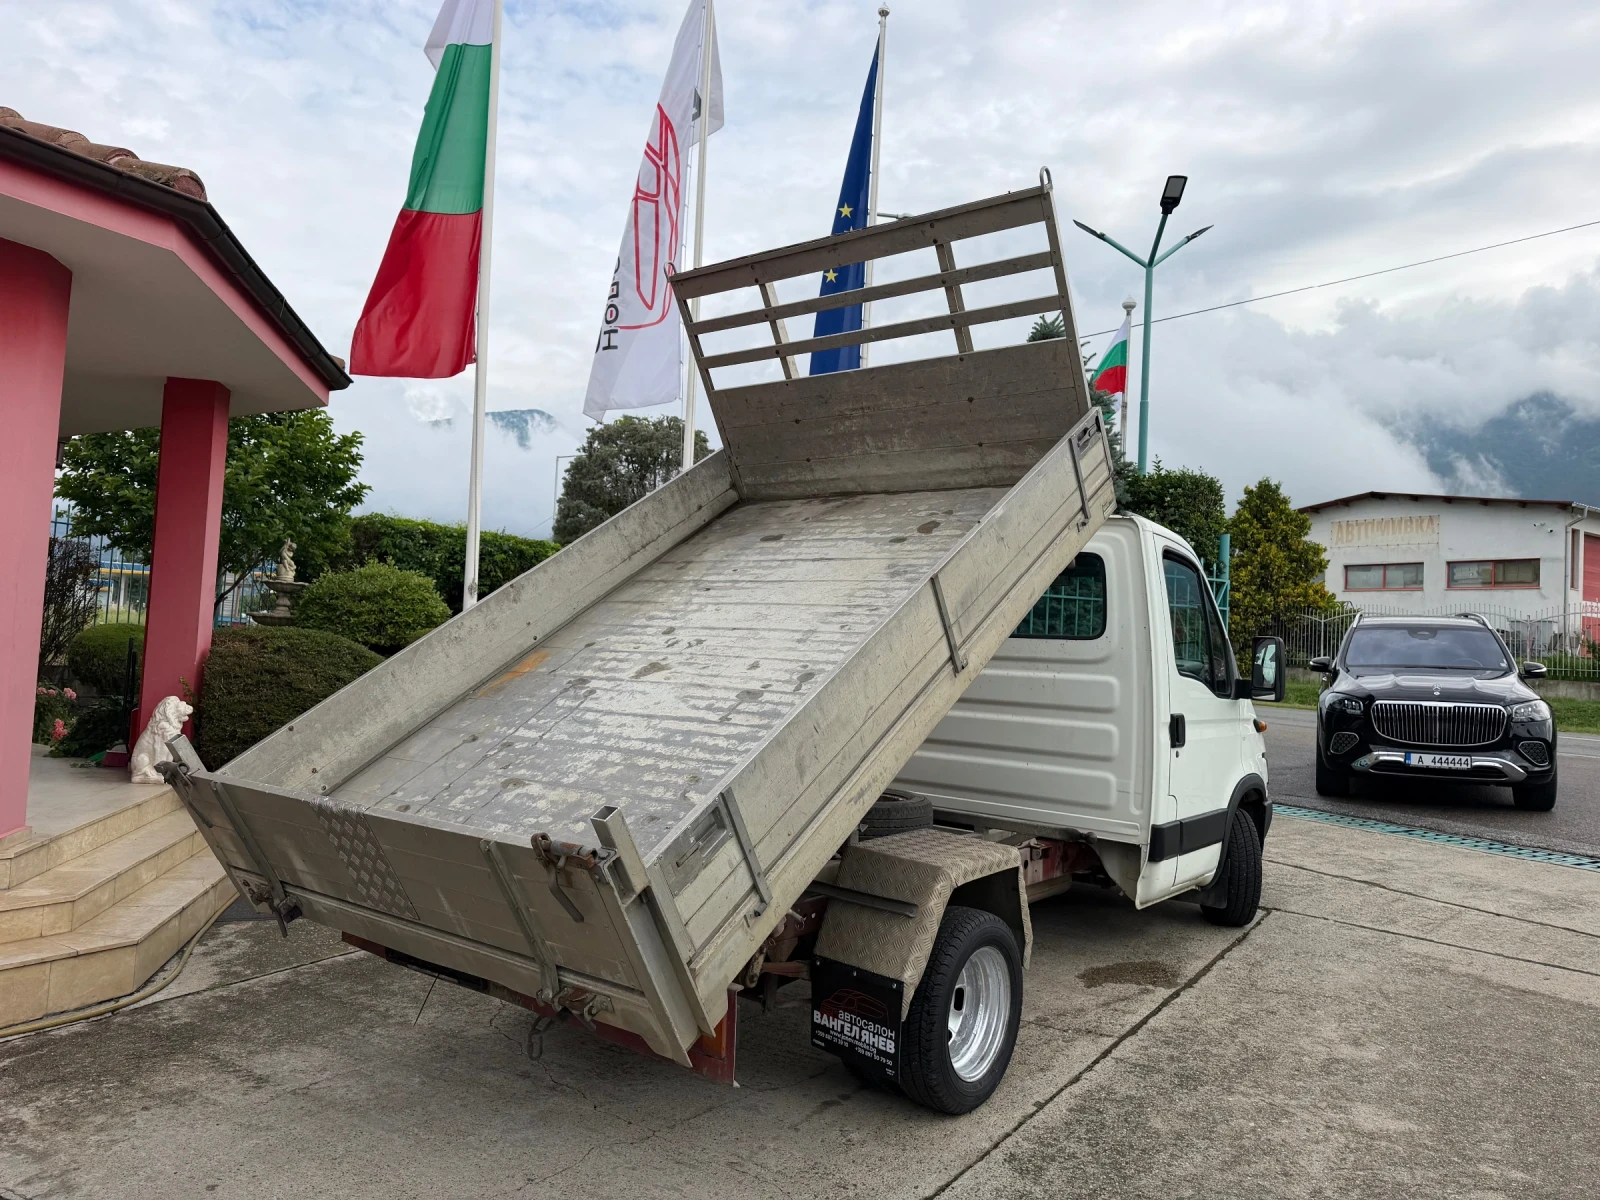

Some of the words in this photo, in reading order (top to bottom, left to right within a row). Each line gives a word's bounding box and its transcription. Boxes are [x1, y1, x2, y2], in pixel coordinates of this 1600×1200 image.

[1335, 517, 1436, 546] АВТОМИВКА
[1431, 756, 1469, 767] 444444
[813, 1009, 860, 1040] ВАНГЕЛ
[861, 1029, 895, 1054] ЯНЕВ
[839, 1010, 895, 1040] автосалон
